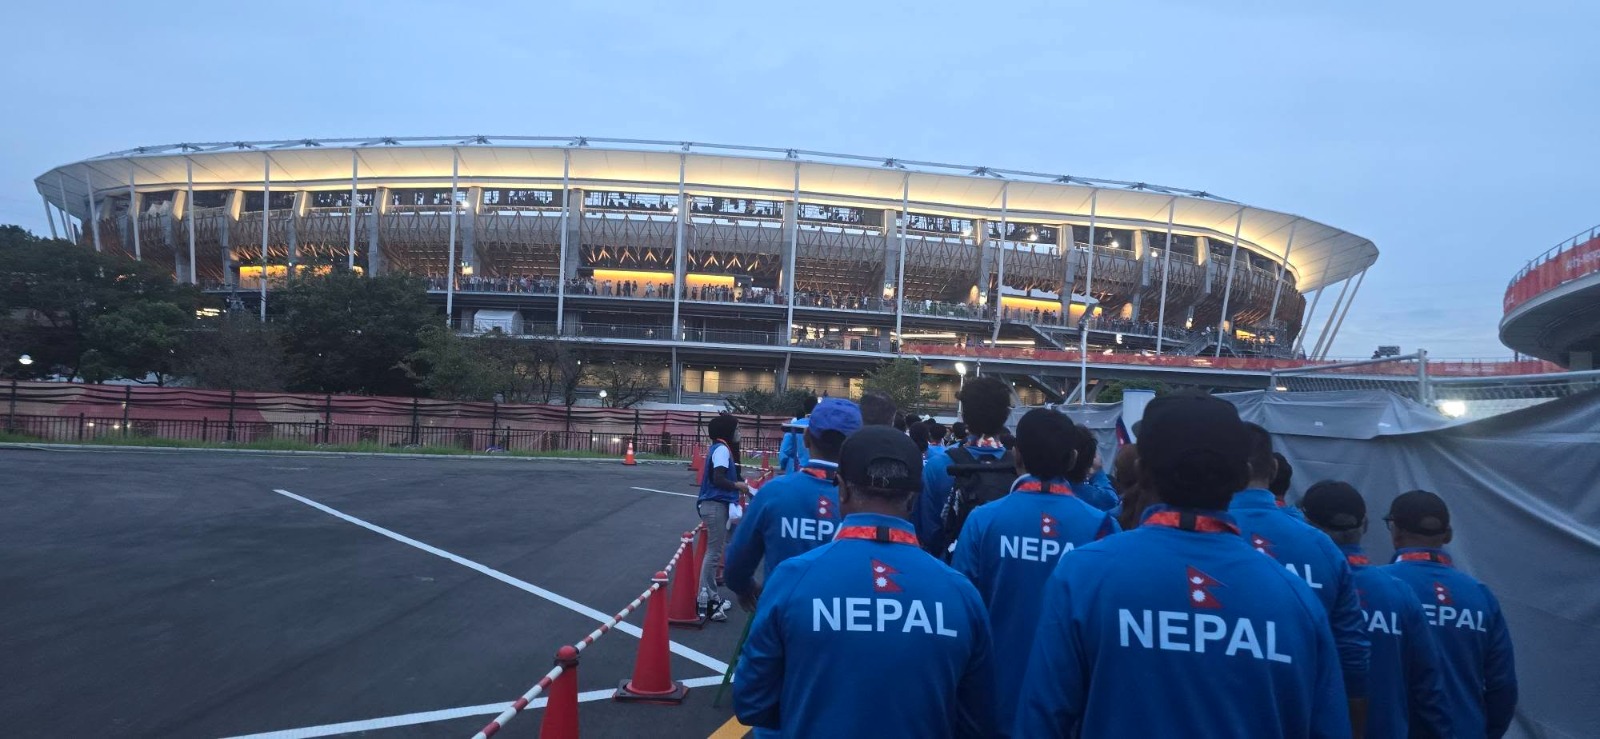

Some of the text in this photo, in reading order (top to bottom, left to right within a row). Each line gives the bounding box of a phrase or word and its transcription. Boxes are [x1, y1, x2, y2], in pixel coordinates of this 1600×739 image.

[781, 516, 842, 541] NEP
[812, 597, 958, 637] NEPAL
[1118, 608, 1292, 663] NEPAL
